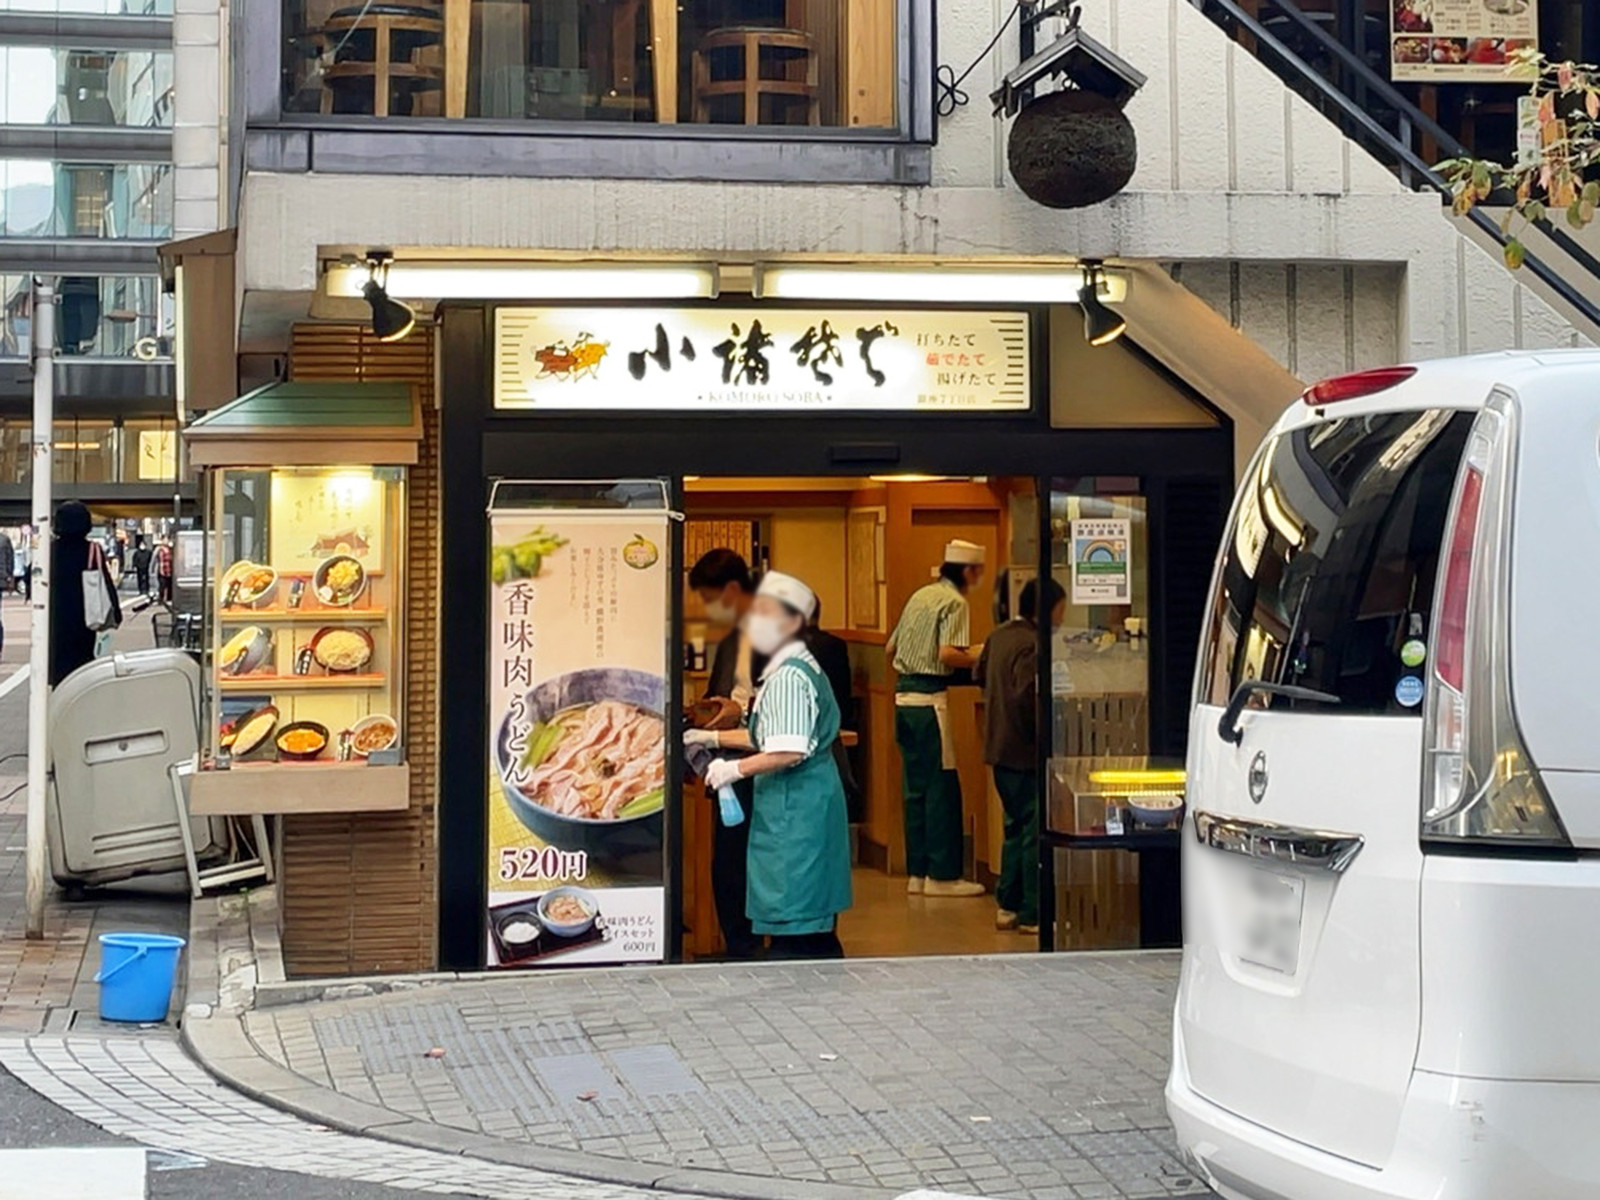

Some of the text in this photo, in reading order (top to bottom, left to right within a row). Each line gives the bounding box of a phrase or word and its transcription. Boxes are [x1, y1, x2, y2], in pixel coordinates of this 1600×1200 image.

[916, 332, 976, 347] 打ちたて
[937, 371, 997, 386] 揚げたて
[503, 582, 535, 784] 香味肉うどん
[500, 847, 588, 879] 520円
[622, 940, 656, 953] 600円
